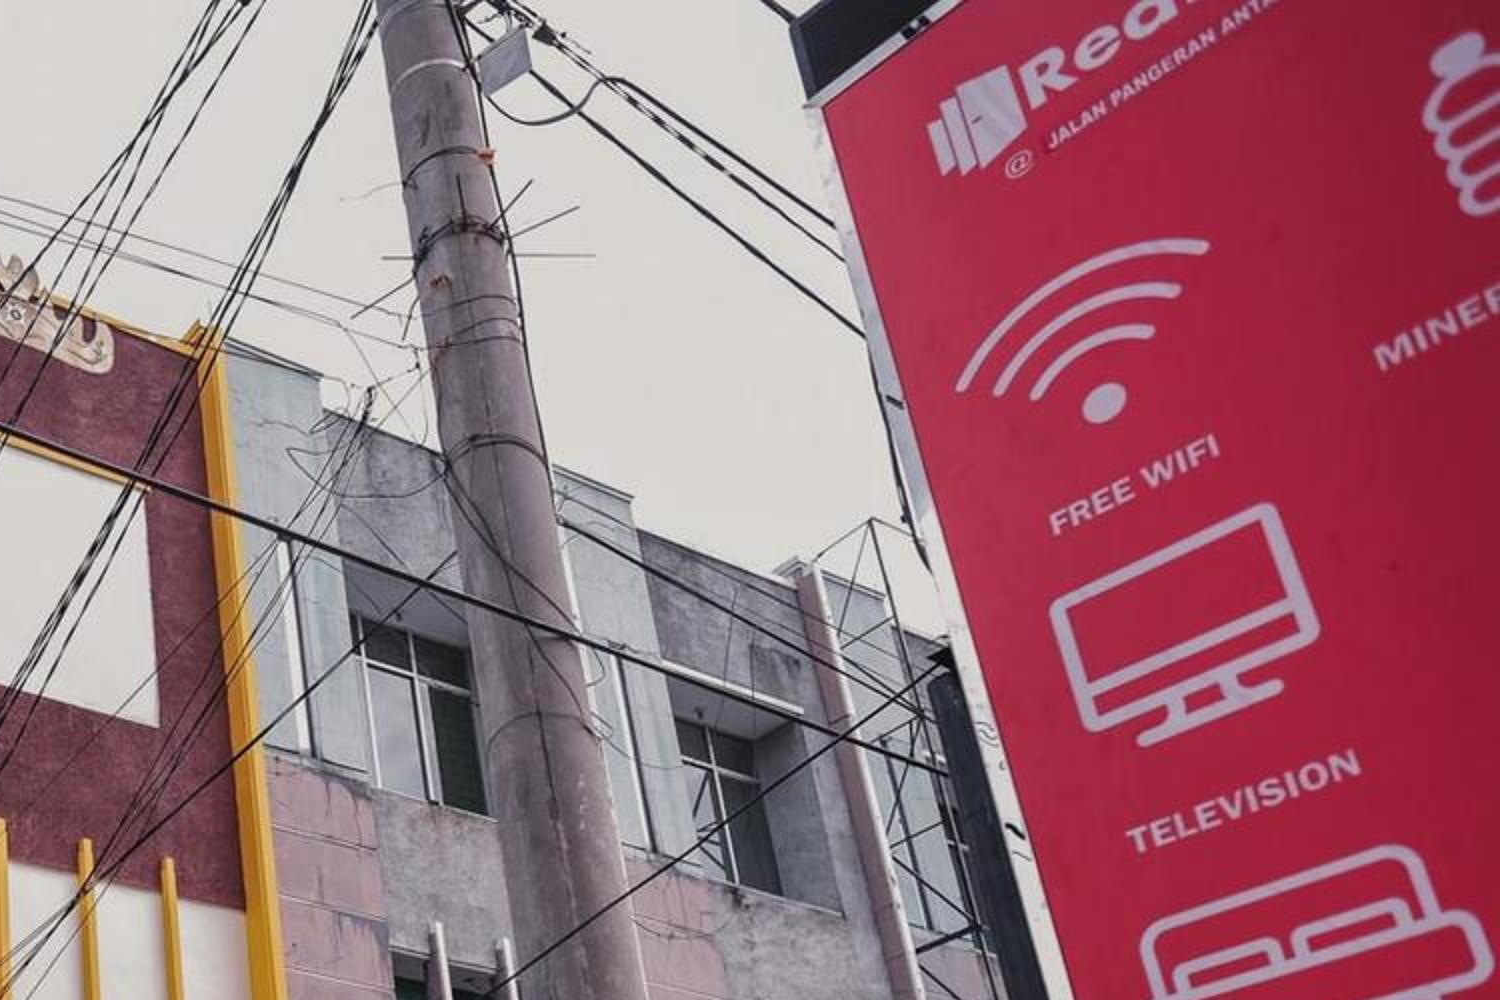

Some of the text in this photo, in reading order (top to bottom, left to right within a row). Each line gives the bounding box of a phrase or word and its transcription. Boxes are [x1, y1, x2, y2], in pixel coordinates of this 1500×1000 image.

[1048, 100, 1108, 149] JALAN
[1108, 28, 1217, 108] PANGERAN
[1048, 433, 1221, 537] FREE WIFI
[1125, 749, 1362, 854] TELEVISION
